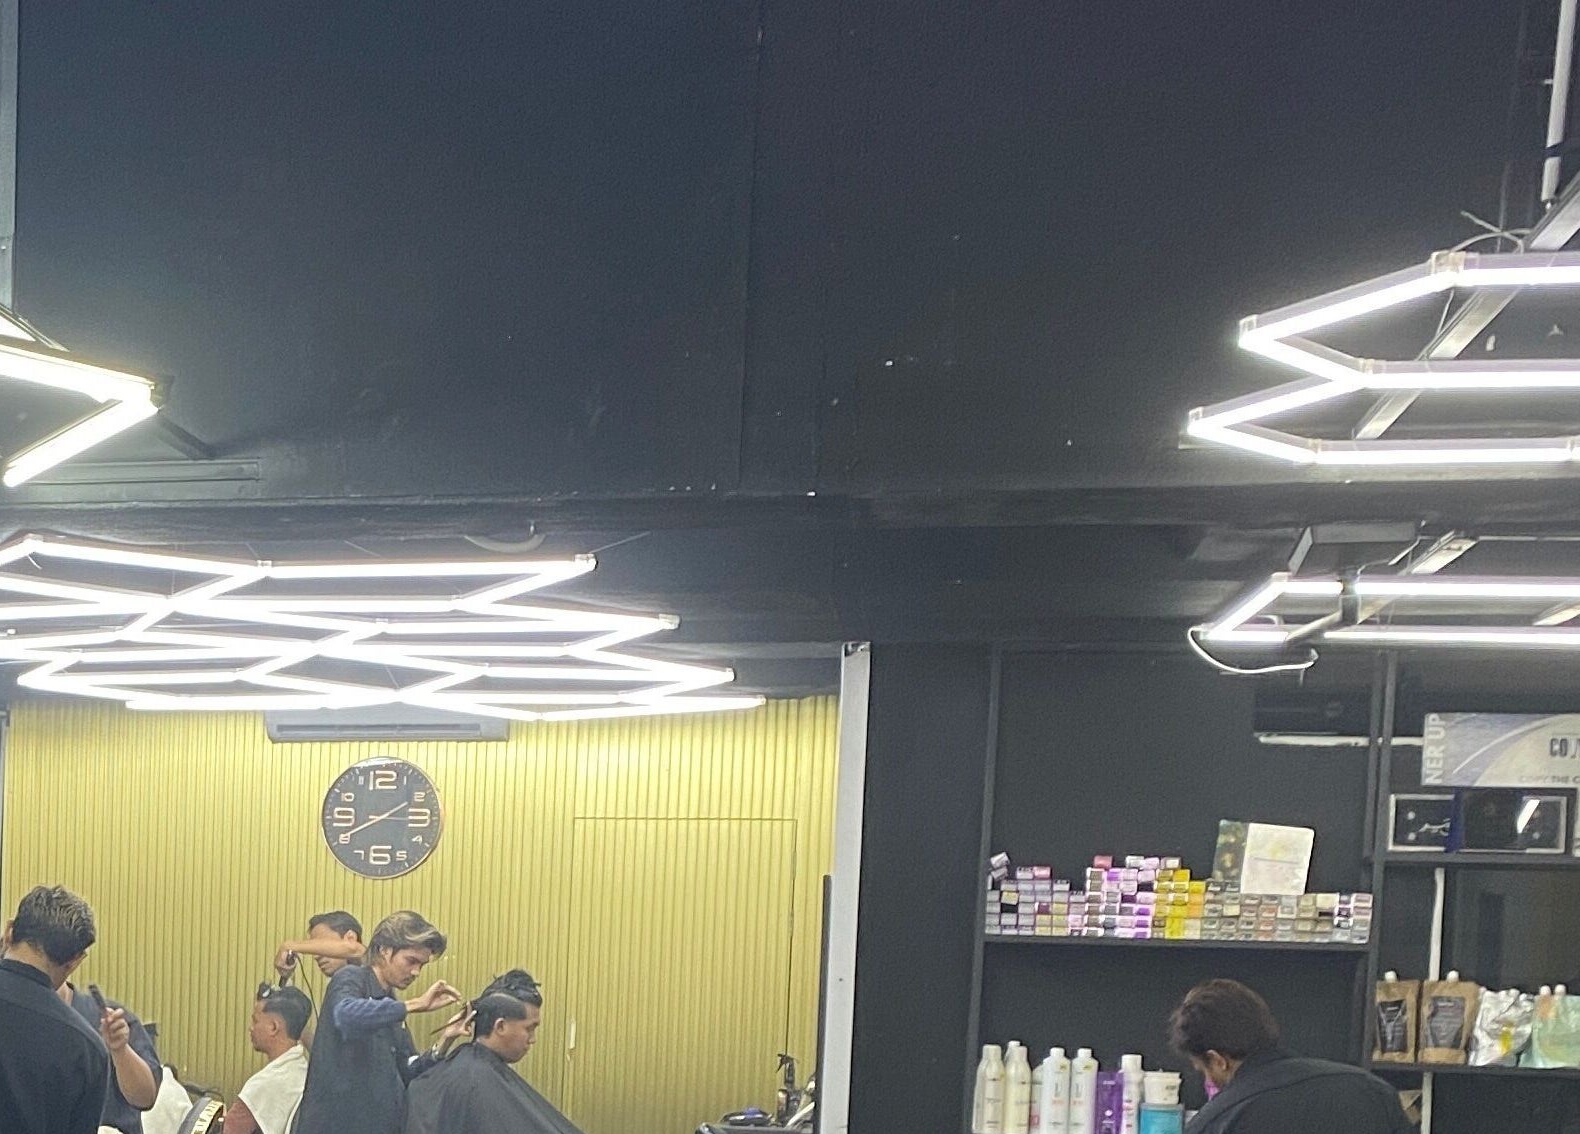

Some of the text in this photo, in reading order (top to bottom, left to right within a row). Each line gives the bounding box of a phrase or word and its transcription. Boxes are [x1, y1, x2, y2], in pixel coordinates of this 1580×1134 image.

[1425, 713, 1446, 738] UP
[369, 770, 397, 791] 12
[341, 792, 355, 802] 10
[413, 792, 426, 802] 2
[332, 807, 356, 827] 9
[408, 808, 431, 828] 3
[412, 834, 423, 845] 4
[353, 850, 365, 860] 7
[369, 845, 392, 865] 6
[396, 850, 408, 861] 5
